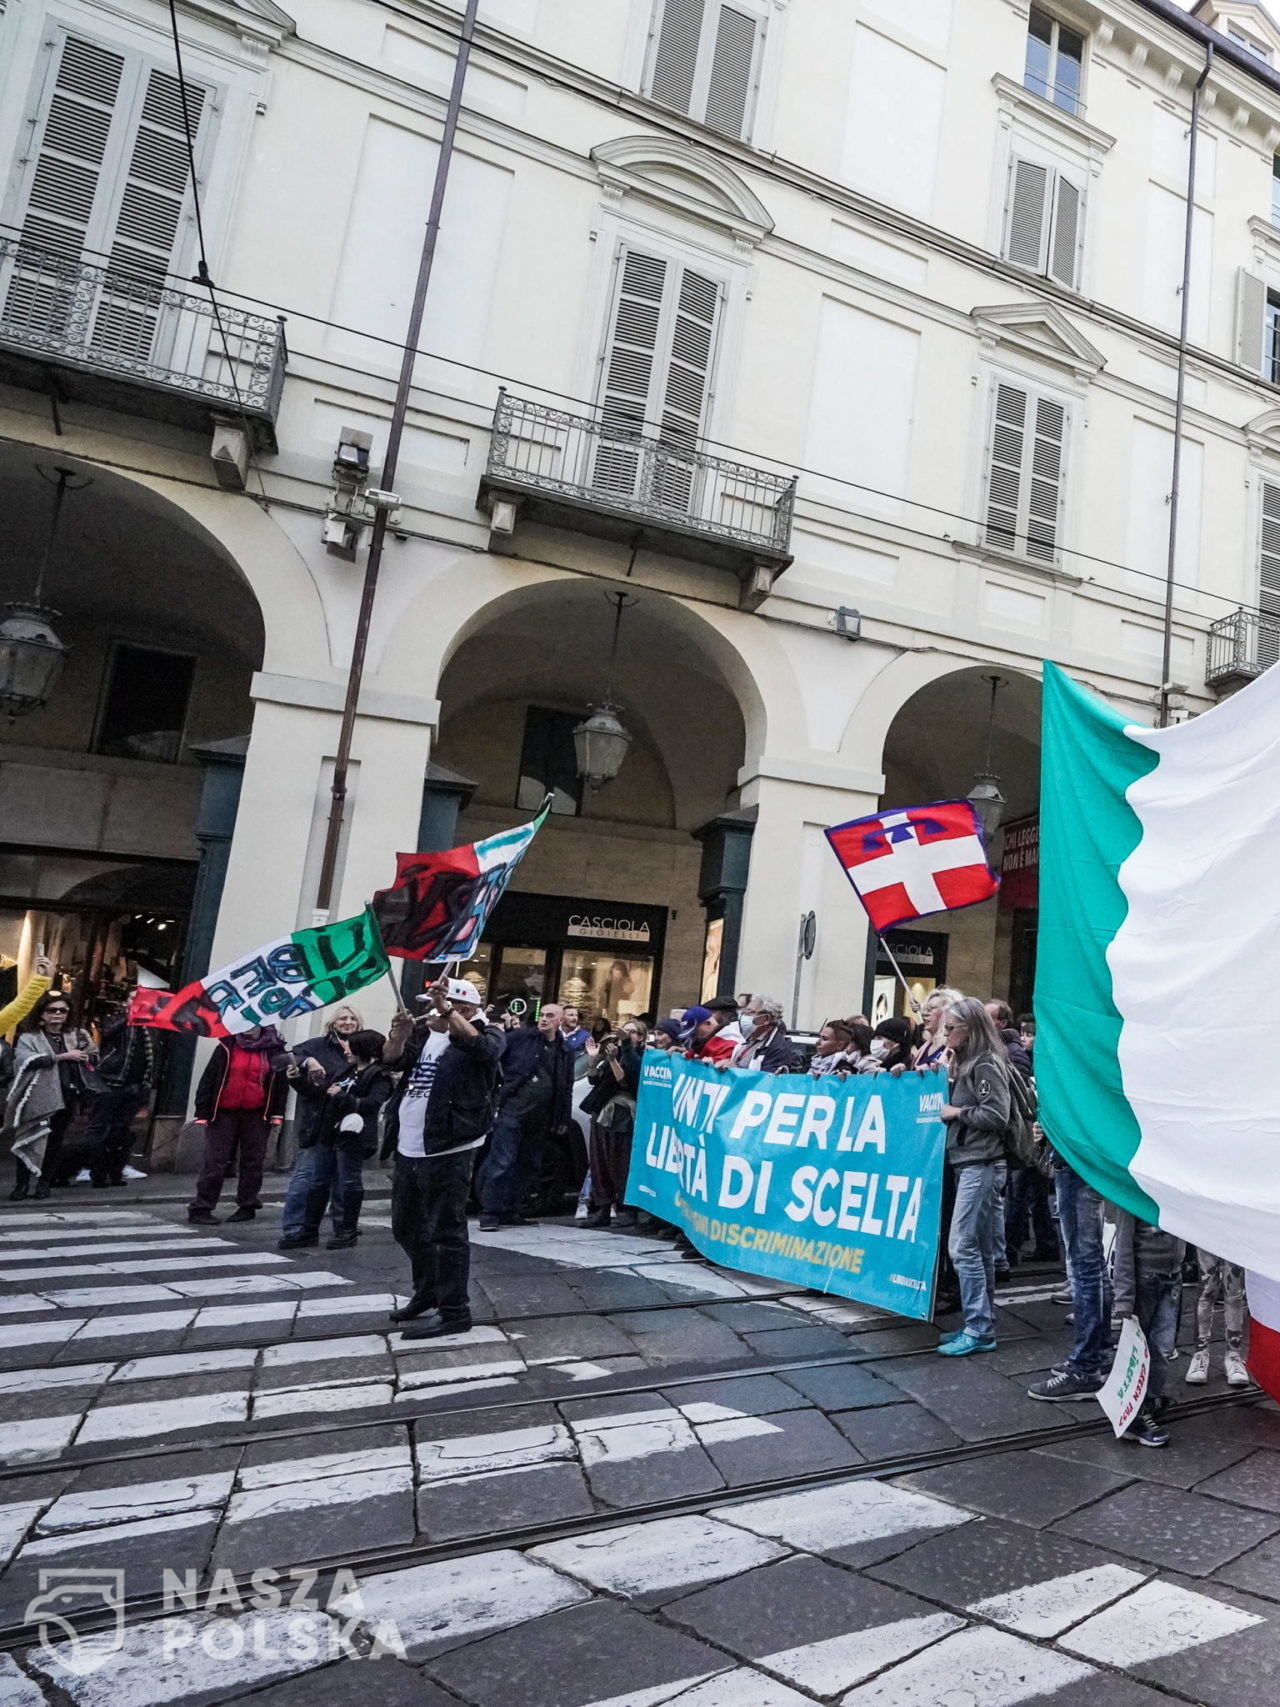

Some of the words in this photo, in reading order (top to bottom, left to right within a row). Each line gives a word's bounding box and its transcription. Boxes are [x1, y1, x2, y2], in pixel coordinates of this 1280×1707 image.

[568, 914, 650, 933] CASCIOLA
[729, 1090, 836, 1150] PER
[837, 1095, 886, 1154] LA
[718, 1154, 773, 1214] DI
[784, 1165, 922, 1243] SCELTA
[710, 1219, 866, 1275] DISCRIMINAZIONE
